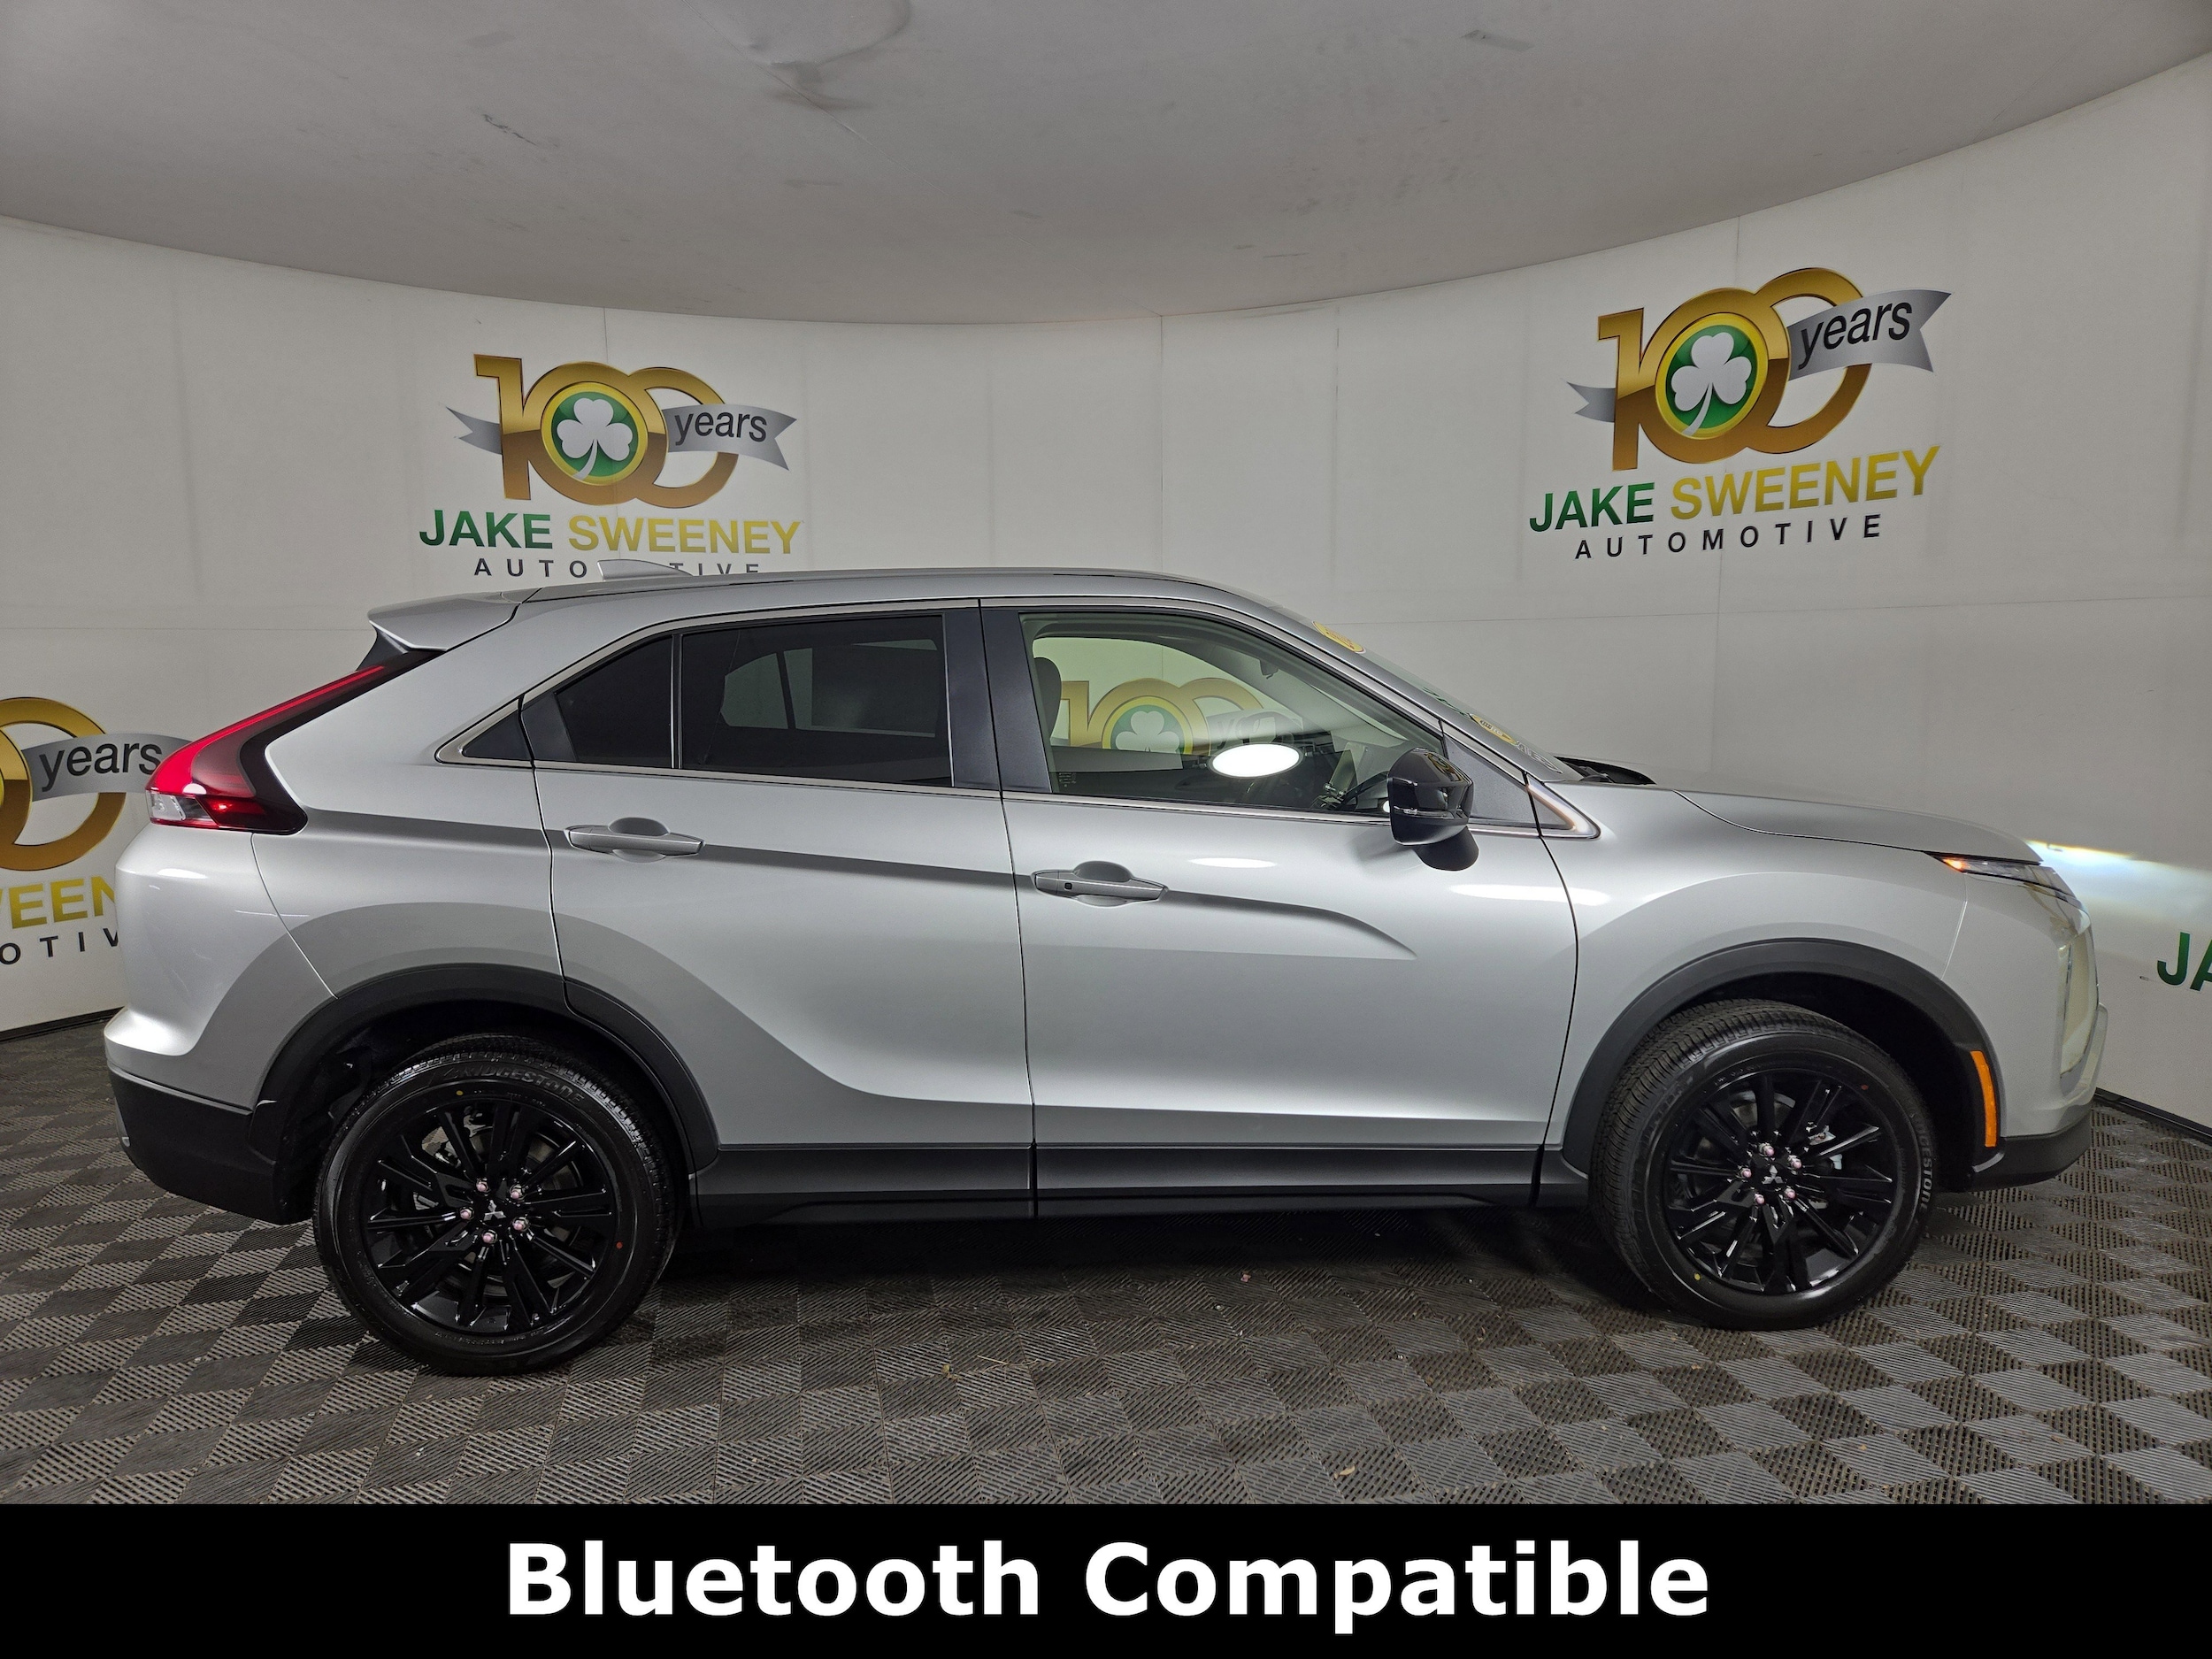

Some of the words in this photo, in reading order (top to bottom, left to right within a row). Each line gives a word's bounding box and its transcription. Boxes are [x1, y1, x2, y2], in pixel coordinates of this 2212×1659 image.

[1798, 302, 1913, 371] years
[1598, 267, 1872, 471] 100
[474, 354, 739, 509] 100
[674, 410, 768, 446] years
[1529, 482, 1655, 533] JAKE
[1671, 446, 1940, 520] SWEENEY
[419, 510, 553, 549] JAKE
[568, 515, 802, 554] SWEENEY
[1575, 514, 1881, 559] AUTOMOTIVE
[39, 742, 163, 791] years
[2157, 932, 2212, 991] JA
